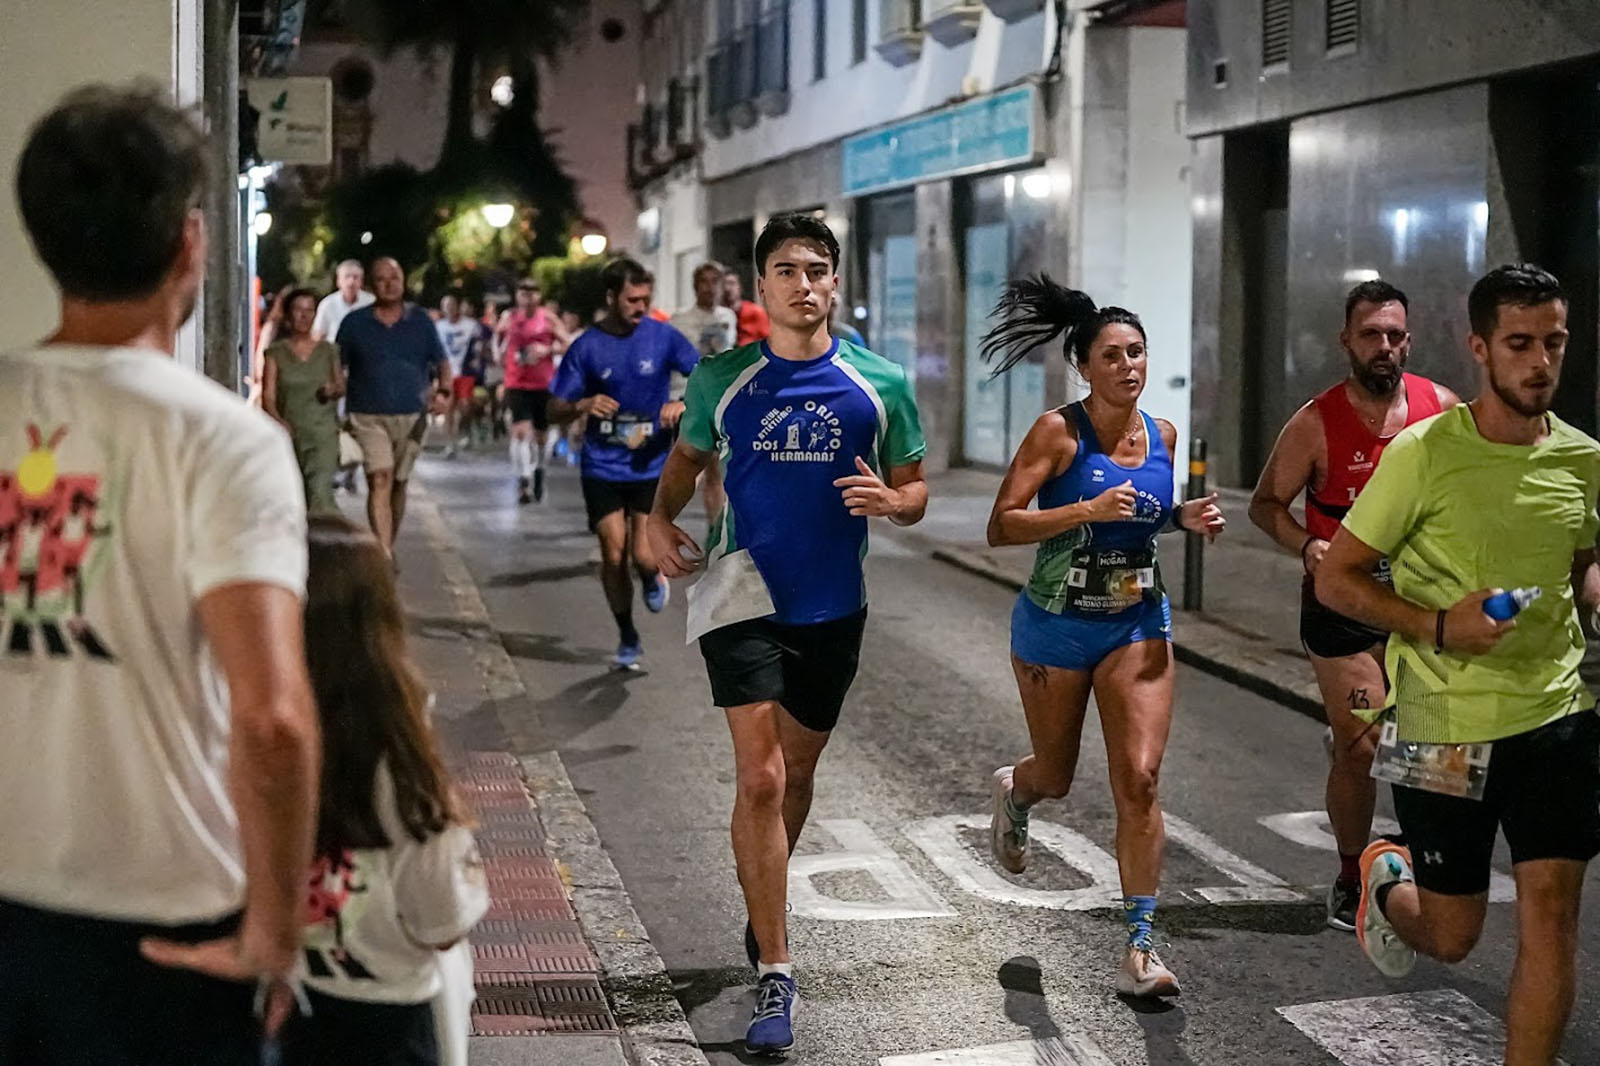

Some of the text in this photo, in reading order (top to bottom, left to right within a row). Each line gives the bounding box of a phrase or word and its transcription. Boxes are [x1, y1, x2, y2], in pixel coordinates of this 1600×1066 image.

[757, 405, 793, 440] ATLETISMO
[760, 408, 780, 426] CLUB
[804, 400, 842, 450] ORIPPO
[752, 439, 778, 451] DOS
[1139, 490, 1162, 518] ORIPPO
